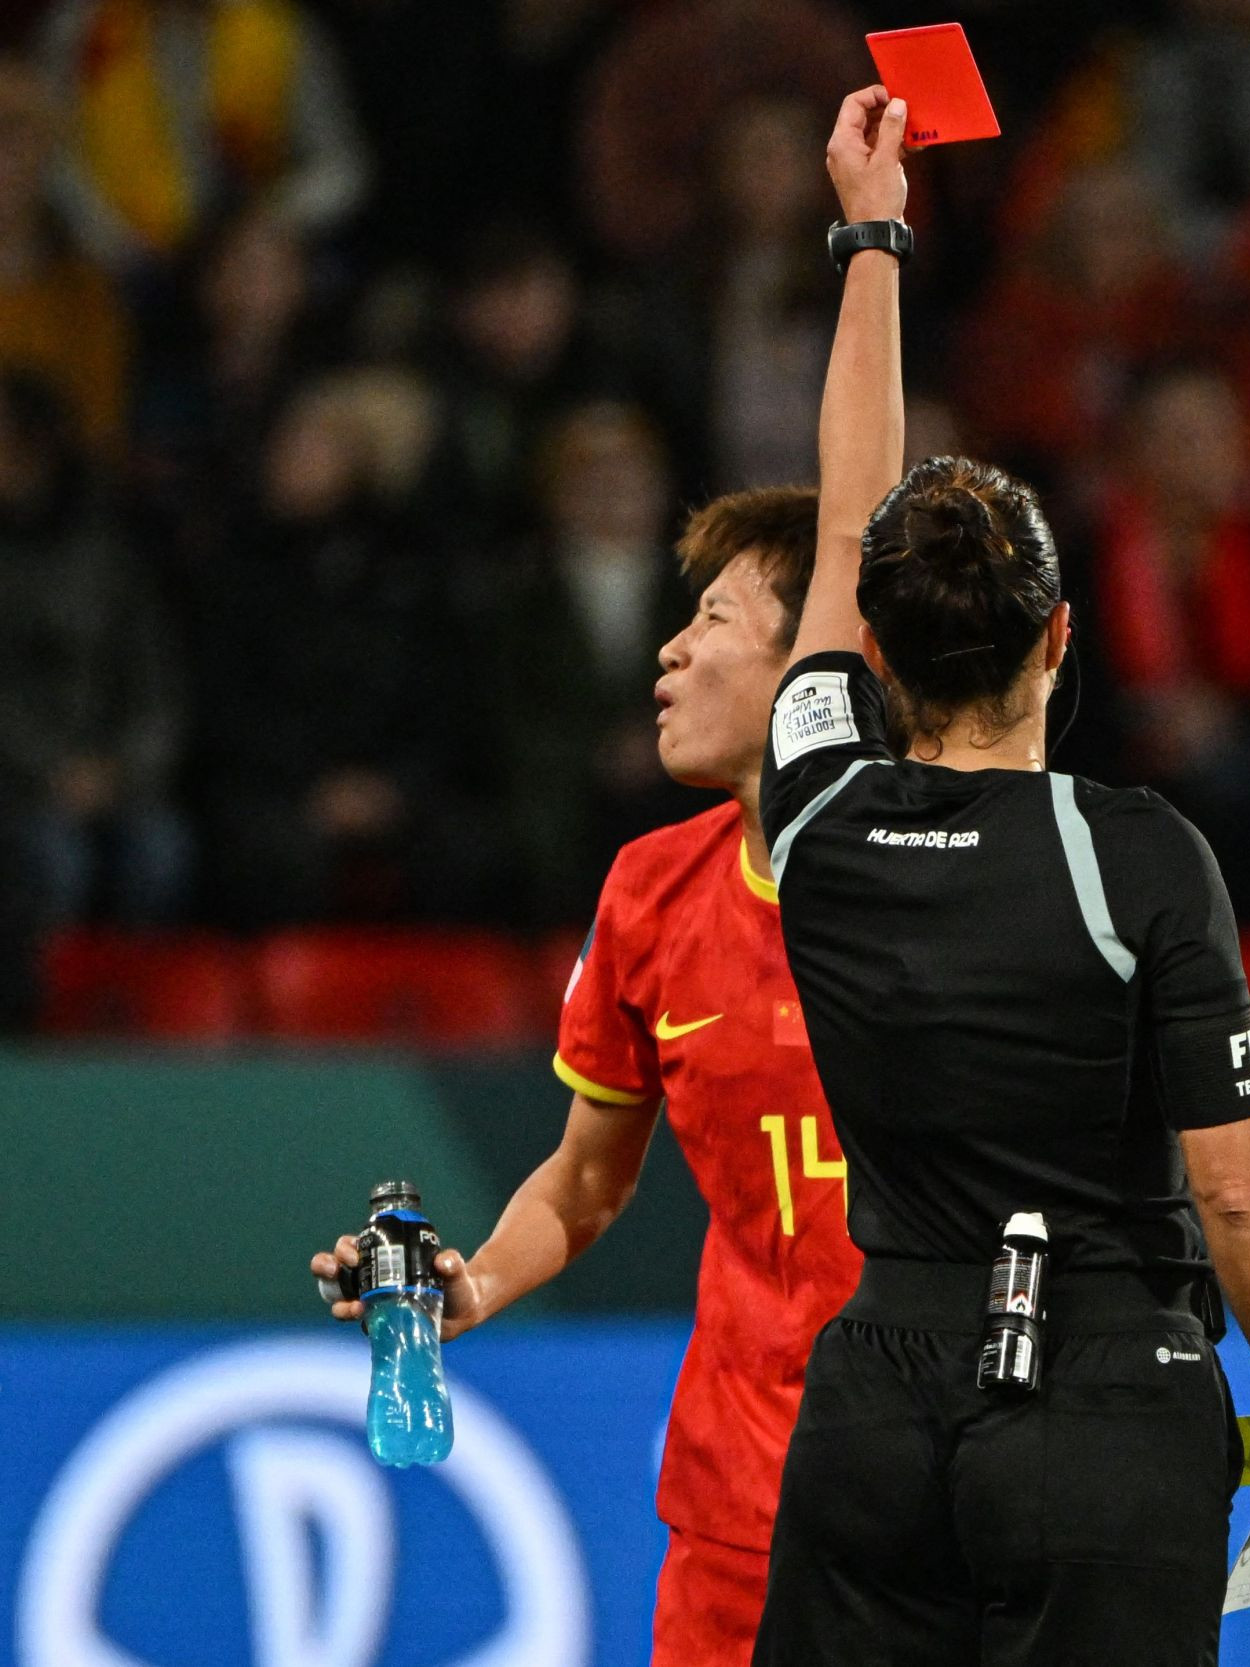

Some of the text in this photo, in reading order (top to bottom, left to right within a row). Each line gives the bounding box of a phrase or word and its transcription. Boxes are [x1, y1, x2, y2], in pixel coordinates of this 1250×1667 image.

[786, 708, 832, 734] UNITES
[788, 720, 836, 743] FOOTBALL
[866, 828, 980, 848] HUERTA DE AZA
[760, 1115, 849, 1237] 14
